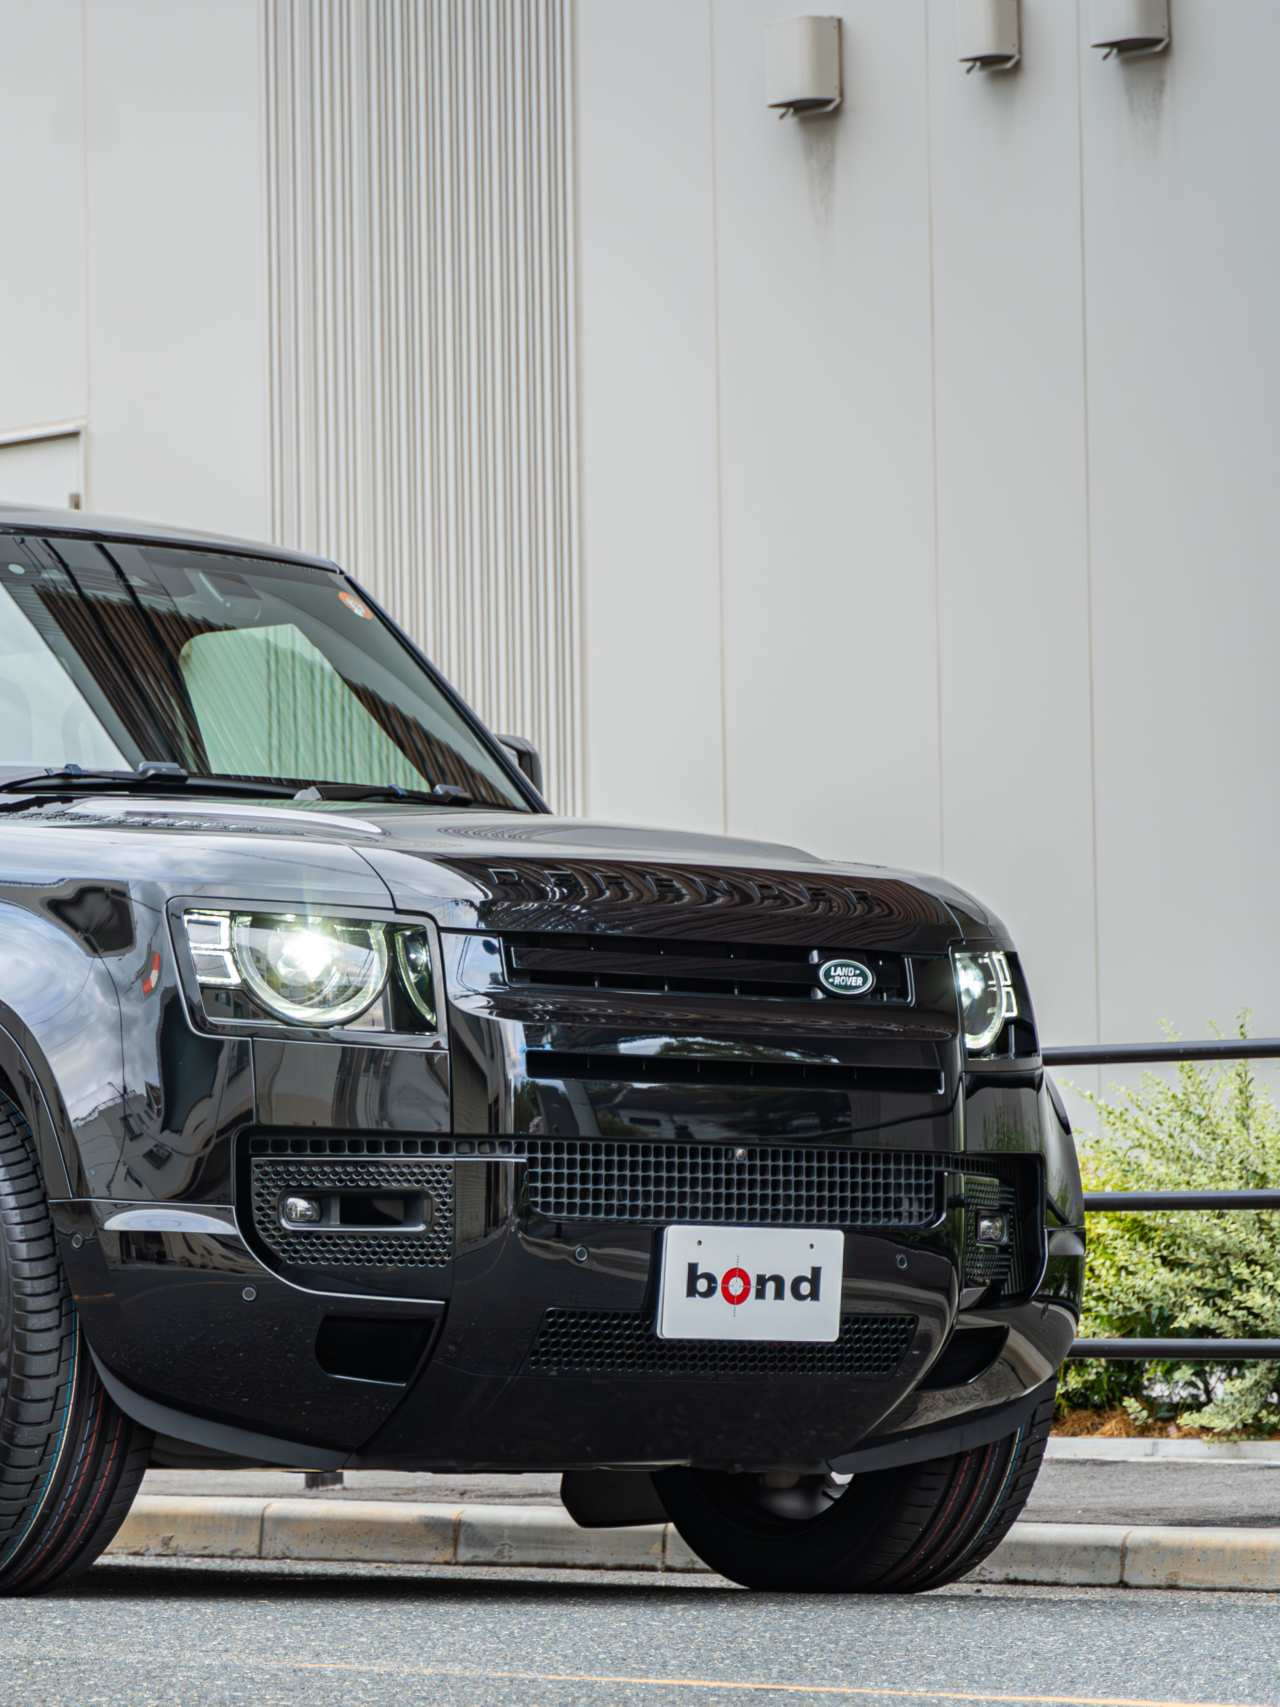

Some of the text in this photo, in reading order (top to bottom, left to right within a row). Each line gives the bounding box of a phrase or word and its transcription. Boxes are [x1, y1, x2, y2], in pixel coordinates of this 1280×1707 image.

[487, 867, 871, 905] DEFENDER
[831, 966, 855, 977] LAND
[833, 976, 863, 987] ROVER
[685, 1261, 823, 1306] bond
